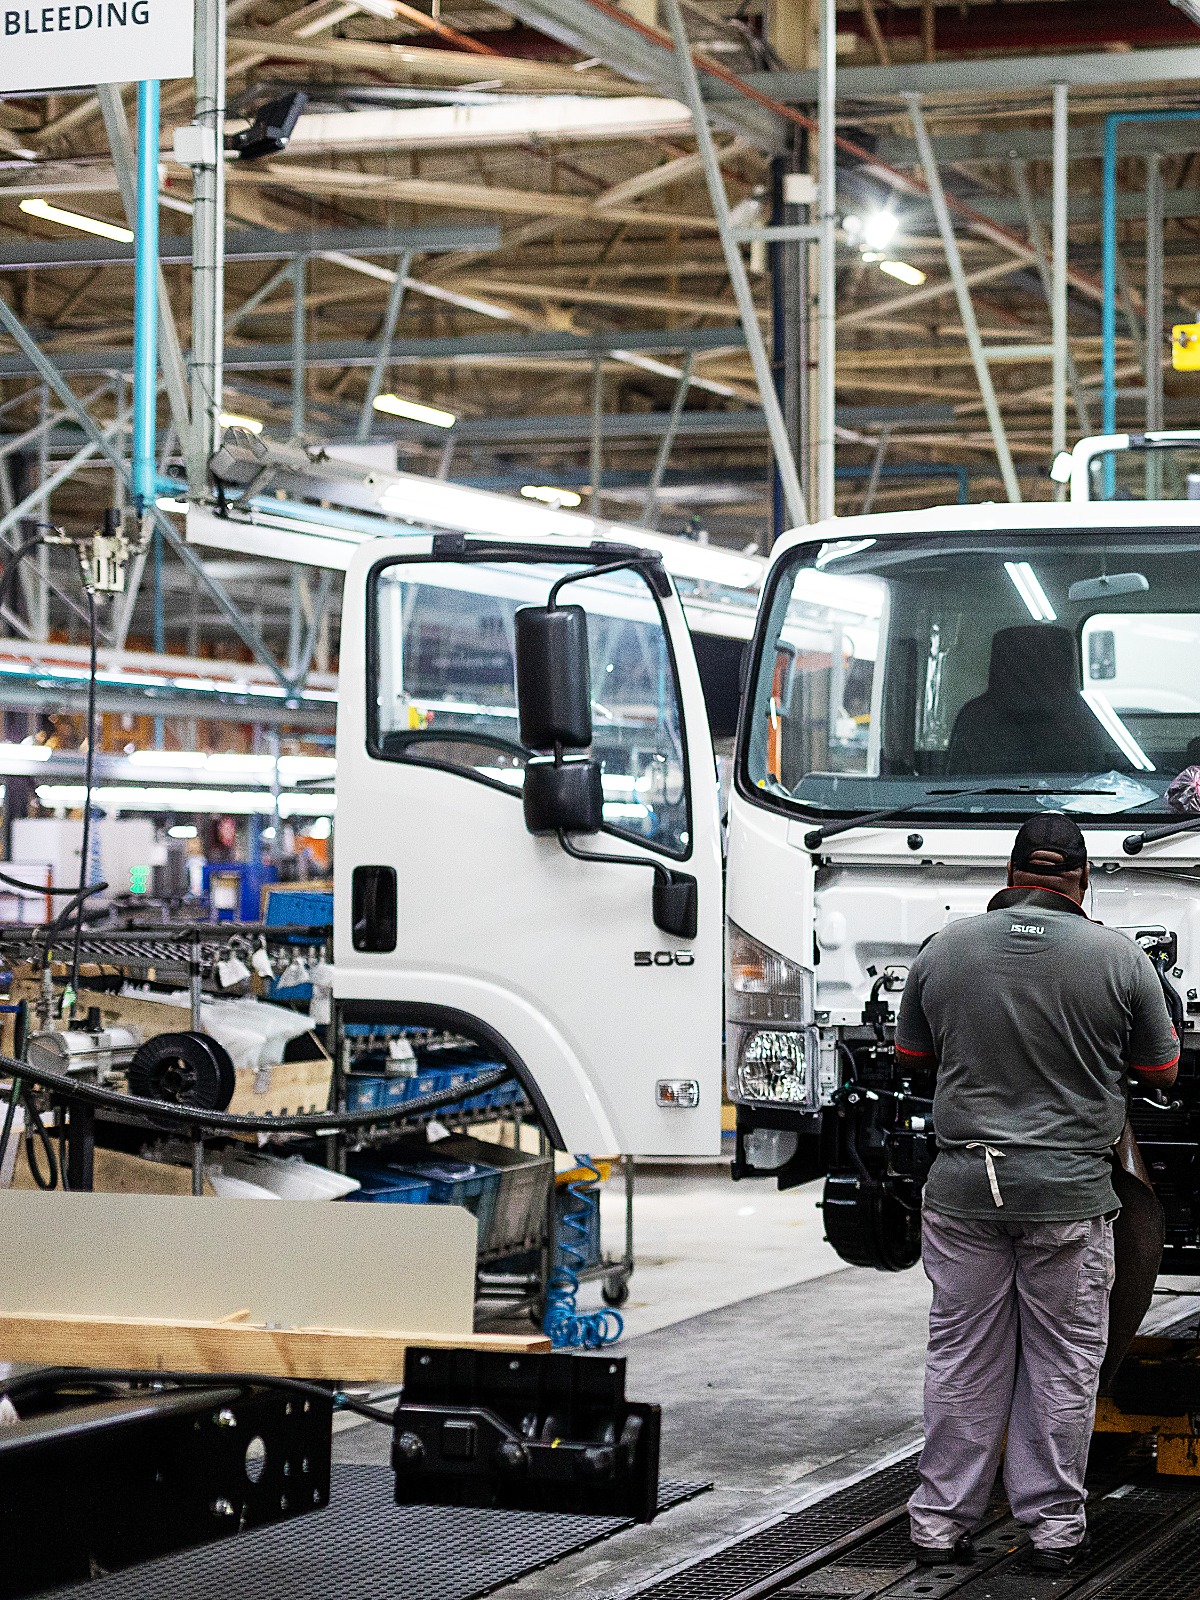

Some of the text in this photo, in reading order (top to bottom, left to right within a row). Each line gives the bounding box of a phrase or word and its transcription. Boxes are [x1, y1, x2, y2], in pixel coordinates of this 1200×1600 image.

[4, 0, 149, 36] BLEEDING
[1010, 924, 1045, 935] ISUZU
[633, 949, 695, 967] 500
